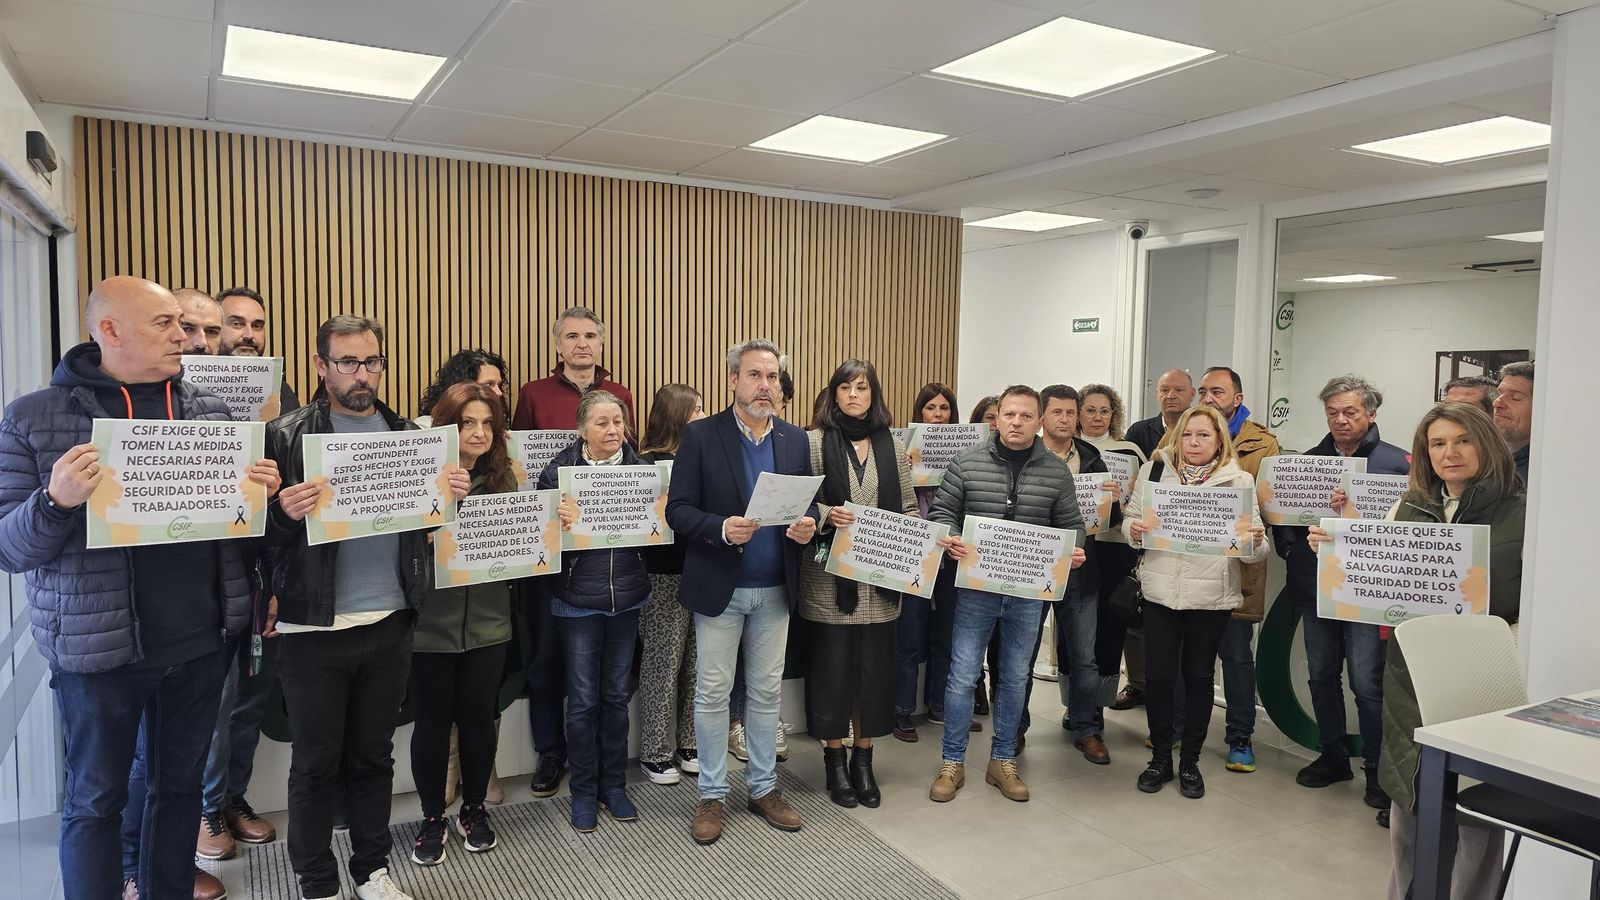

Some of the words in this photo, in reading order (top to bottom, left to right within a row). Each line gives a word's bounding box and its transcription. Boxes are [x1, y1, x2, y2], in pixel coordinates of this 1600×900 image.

[187, 364, 230, 373] CONDENA
[231, 365, 241, 373] DE
[242, 365, 270, 373] FORMA
[190, 375, 249, 384] CONTUNDENTE
[224, 396, 246, 405] PARA
[247, 396, 265, 405] QUE
[131, 425, 159, 436] CSIF
[161, 425, 196, 436] EXIGE
[198, 426, 221, 438] QUE
[223, 426, 236, 437] SE
[121, 440, 165, 451] TOMEN
[168, 440, 191, 451] LAS
[193, 441, 243, 451] MEDIDAS
[326, 442, 348, 452] CSIF
[350, 440, 397, 451] CONDENA
[399, 438, 410, 447] DE
[411, 436, 443, 446] FORMA
[523, 442, 549, 451] TOMEN
[126, 455, 202, 466] NECESARIAS
[204, 455, 235, 466] PARA
[352, 448, 418, 462] CONTUNDENTE
[334, 464, 363, 475] ESTOS
[364, 460, 402, 471] HECHOS
[410, 457, 436, 466] EXIGE
[1316, 459, 1333, 467] QUE
[122, 470, 220, 482] SALVAGUARDAR
[223, 469, 237, 480] LA
[329, 475, 350, 486] QUE
[350, 474, 362, 483] SE
[363, 471, 393, 482] ACTÚE
[394, 468, 419, 478] PARA
[419, 466, 438, 477] QUE
[124, 485, 194, 498] SEGURIDAD
[196, 484, 211, 495] DE
[213, 484, 237, 494] LOS
[340, 484, 368, 495] ESTAS
[369, 478, 426, 492] AGRESIONES
[591, 480, 640, 488] CONTUNDENTE
[1273, 483, 1335, 492] SALVAGUARDAR
[1365, 480, 1399, 488] CONDENA
[337, 497, 352, 506] NO
[352, 492, 395, 504] VUELVAN
[397, 488, 429, 499] NUNCA
[481, 496, 507, 507] EXIGE
[508, 495, 527, 505] QUE
[528, 494, 538, 502] SE
[576, 499, 591, 507] QUE
[641, 496, 655, 505] QUE
[1168, 490, 1202, 498] CONDENA
[1169, 497, 1218, 506] CONTUNDENTE
[131, 498, 230, 513] TRABAJADORES.
[360, 500, 418, 515] PRODUCIRSE.
[459, 509, 486, 519] OMEN
[487, 507, 505, 517] LAS
[506, 504, 544, 515] MEDIDAS
[604, 505, 646, 514] AGRESIONES
[1278, 500, 1335, 510] TRABAJADORE
[459, 517, 514, 530] NECESARIAS
[515, 515, 539, 524] PARA
[597, 522, 641, 531] PRODUCIRSE.
[863, 509, 881, 518] CSIF
[880, 513, 903, 524] EXIGE
[903, 518, 919, 528] QUE
[919, 522, 929, 531] SE
[456, 526, 528, 541] SALVAGUARDAR
[529, 525, 541, 533] LA
[855, 516, 883, 529] TOMEN
[882, 523, 898, 532] LAS
[897, 526, 931, 540] MEDIDAS
[993, 525, 1026, 536] CONDENA
[1036, 532, 1061, 541] FORMA
[1350, 523, 1374, 533] CSIF
[1376, 525, 1409, 536] EXIGE
[1411, 526, 1436, 538] QUE
[1439, 528, 1454, 538] SE
[458, 539, 509, 552] SEGURIDAD
[509, 537, 521, 546] DE
[522, 535, 540, 545] LOS
[857, 526, 903, 543] NECESARIAS
[903, 537, 924, 548] PARA
[993, 533, 1042, 547] CONTUNDENTE
[1343, 535, 1382, 547] TOMEN
[1384, 538, 1406, 549] LAS
[1408, 540, 1462, 552] MEDIDAS
[853, 535, 912, 555] SALVAGUARDAR
[913, 549, 923, 558] LA
[464, 547, 534, 562] TRABAJADORES.
[852, 544, 894, 560] SEGURIDAD
[893, 554, 904, 562] DE
[904, 556, 920, 566] LOS
[1349, 548, 1419, 563] NECESARIAS
[1421, 554, 1455, 565] PARA
[854, 554, 912, 574] TRABAJADORES.
[1345, 561, 1439, 578] SALVAGUARDAR
[1442, 569, 1458, 579] LA
[1347, 574, 1411, 588] SEGURIDAD
[1414, 580, 1429, 590] DE
[1432, 581, 1456, 592] LOS
[1353, 587, 1448, 605] TRABAJADORES.
